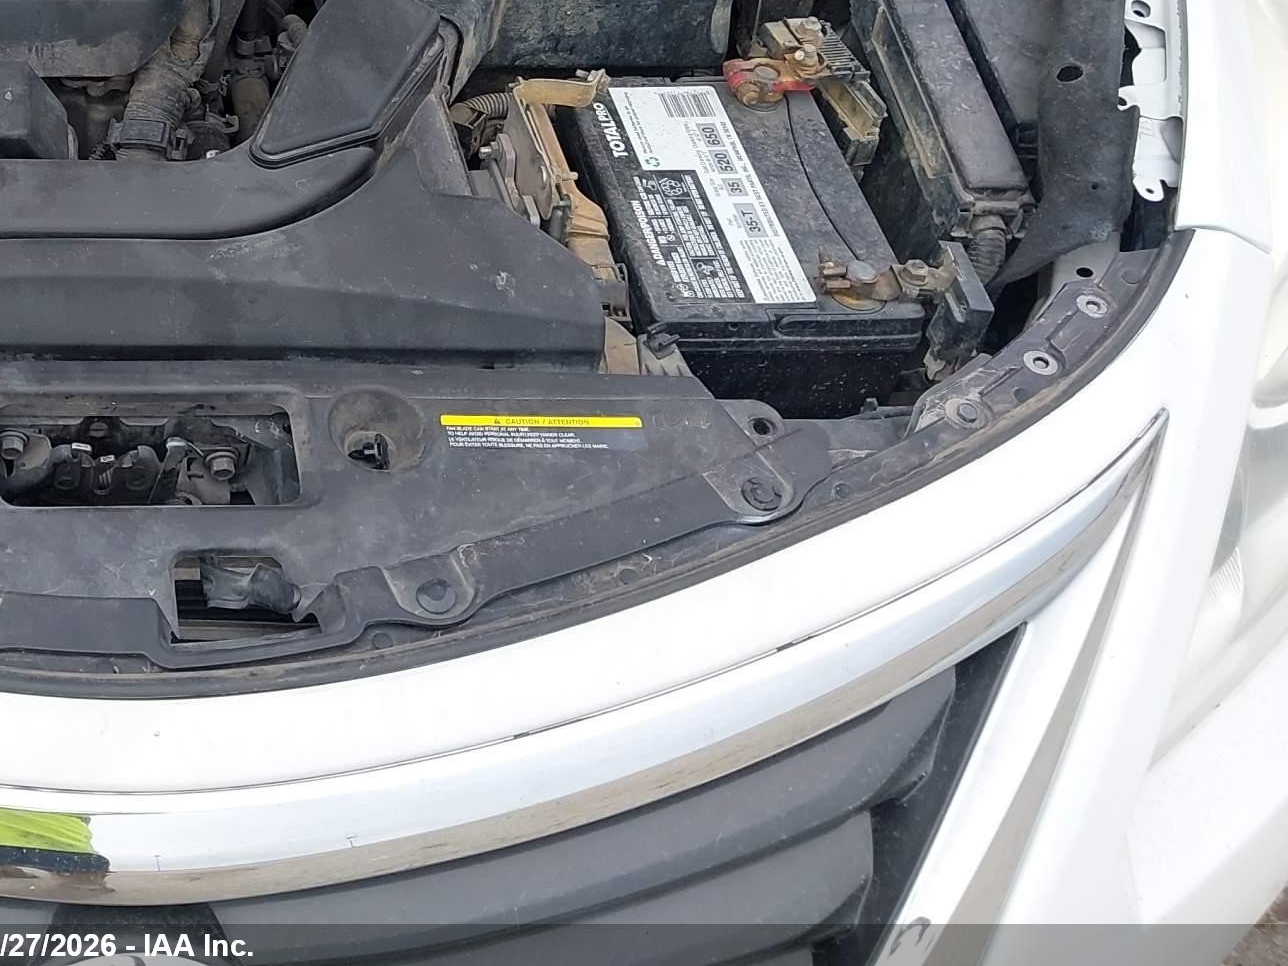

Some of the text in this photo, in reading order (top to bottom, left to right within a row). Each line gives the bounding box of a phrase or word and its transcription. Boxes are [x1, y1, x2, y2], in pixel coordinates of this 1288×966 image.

[593, 102, 628, 158] TOTALPRO
[702, 127, 720, 145] 650
[715, 153, 733, 172] 520
[728, 181, 742, 193] 35
[753, 189, 762, 201] BEST
[741, 210, 761, 232] 35-T
